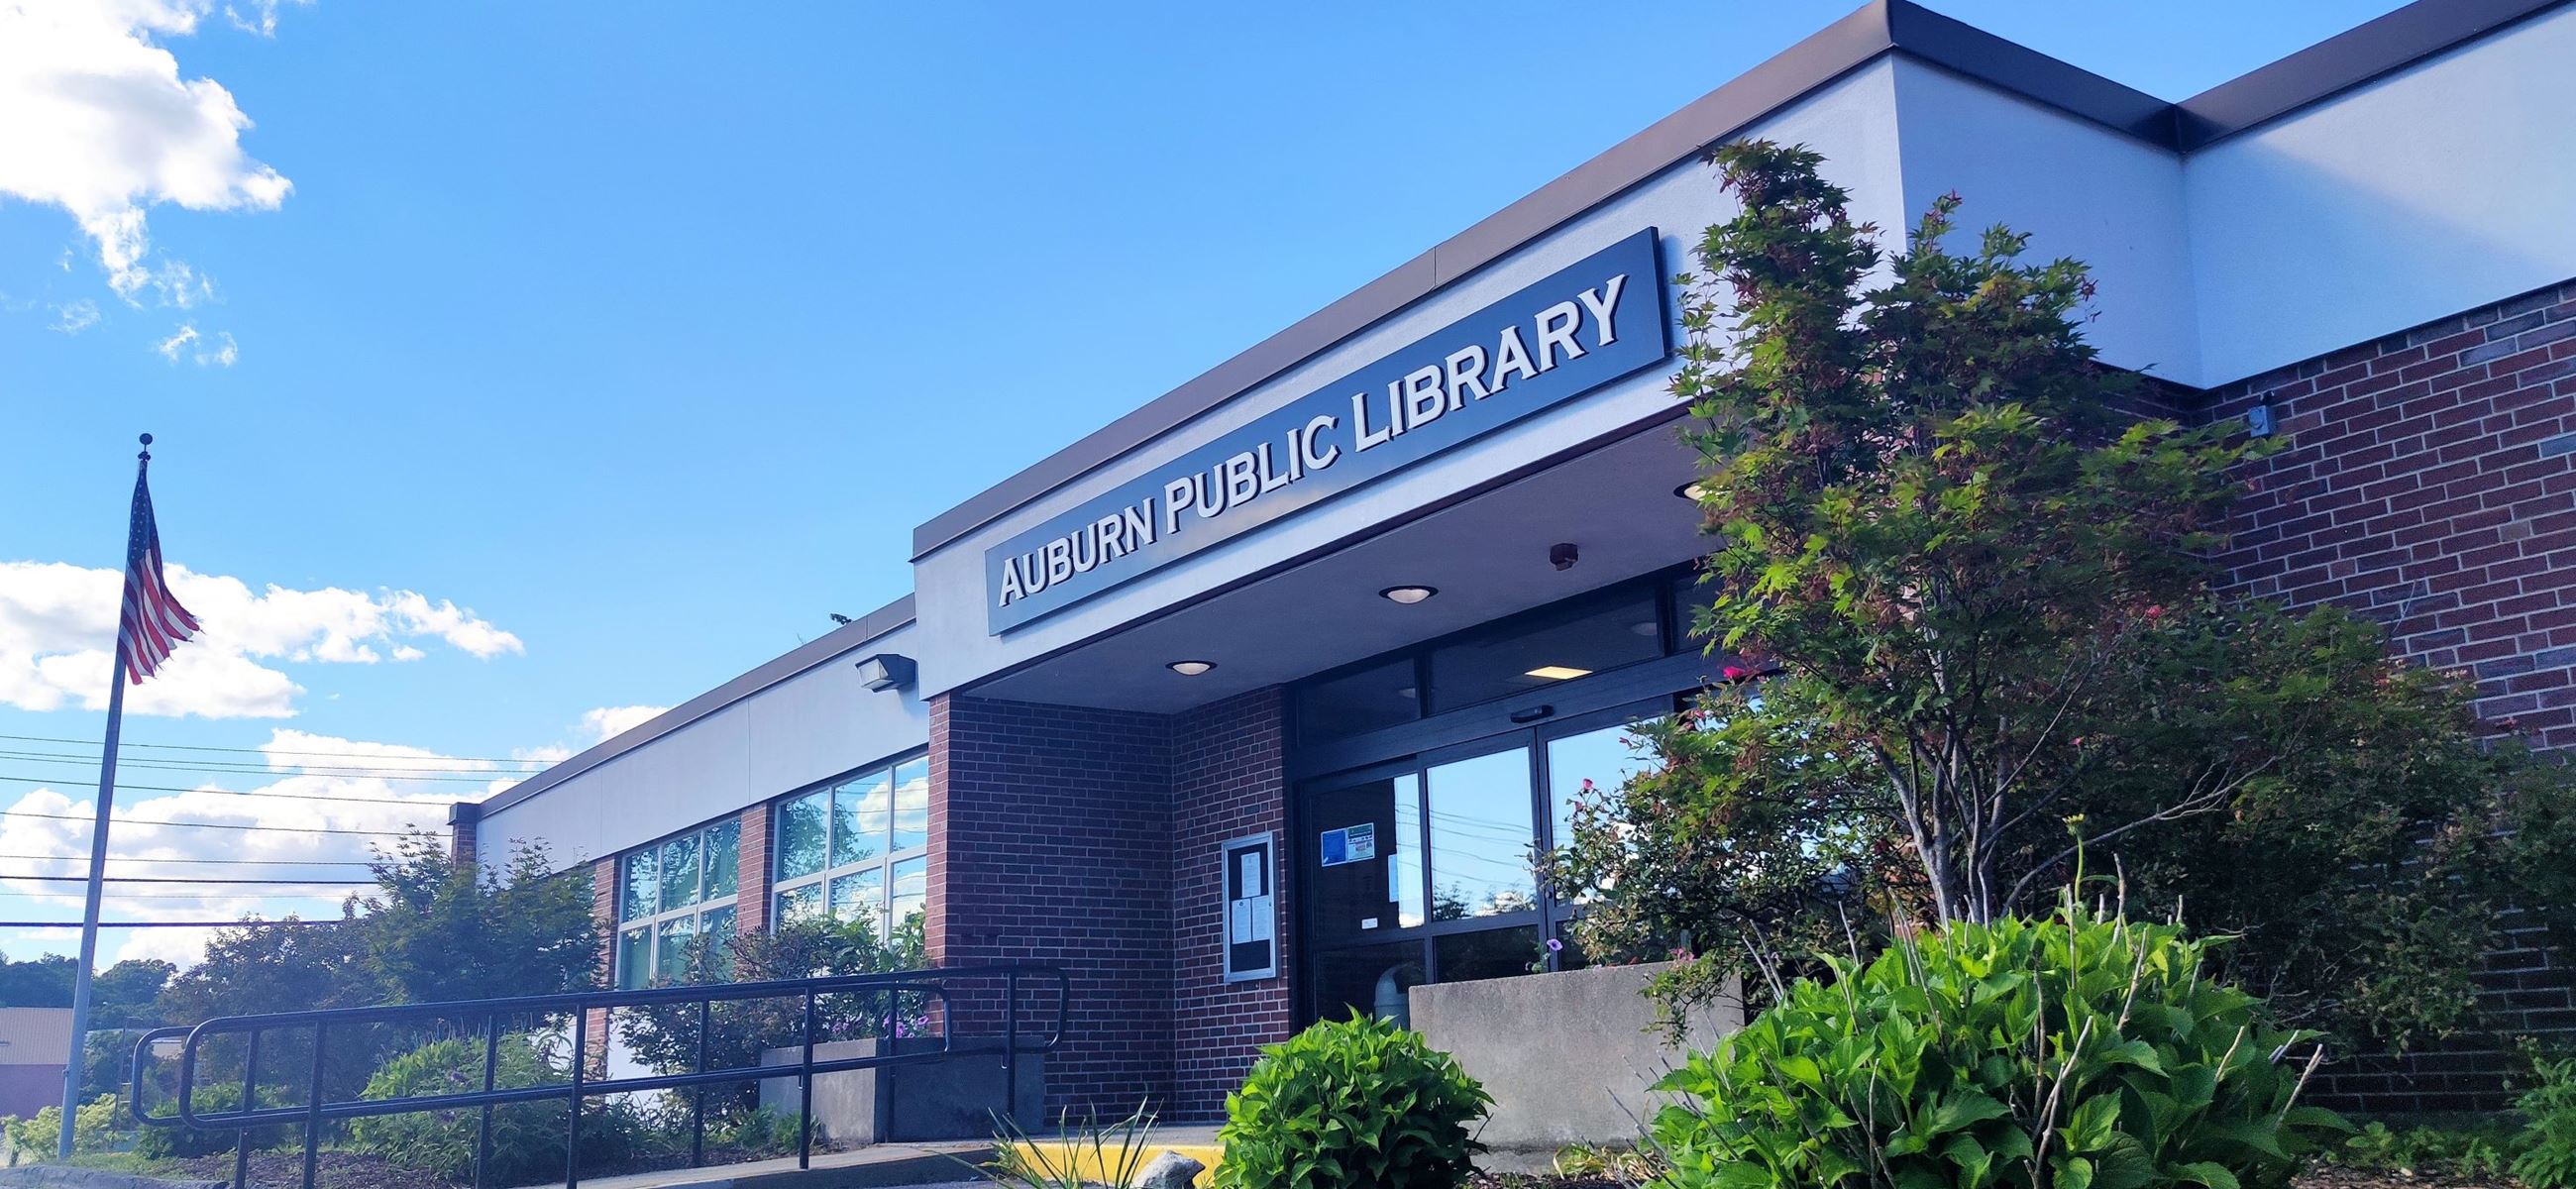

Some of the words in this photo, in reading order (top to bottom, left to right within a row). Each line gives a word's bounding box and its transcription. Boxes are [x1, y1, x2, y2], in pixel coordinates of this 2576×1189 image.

[998, 497, 1157, 607] AUBURN
[1163, 414, 1340, 532] PUBLIC
[1350, 273, 1627, 452] LIBRARY
